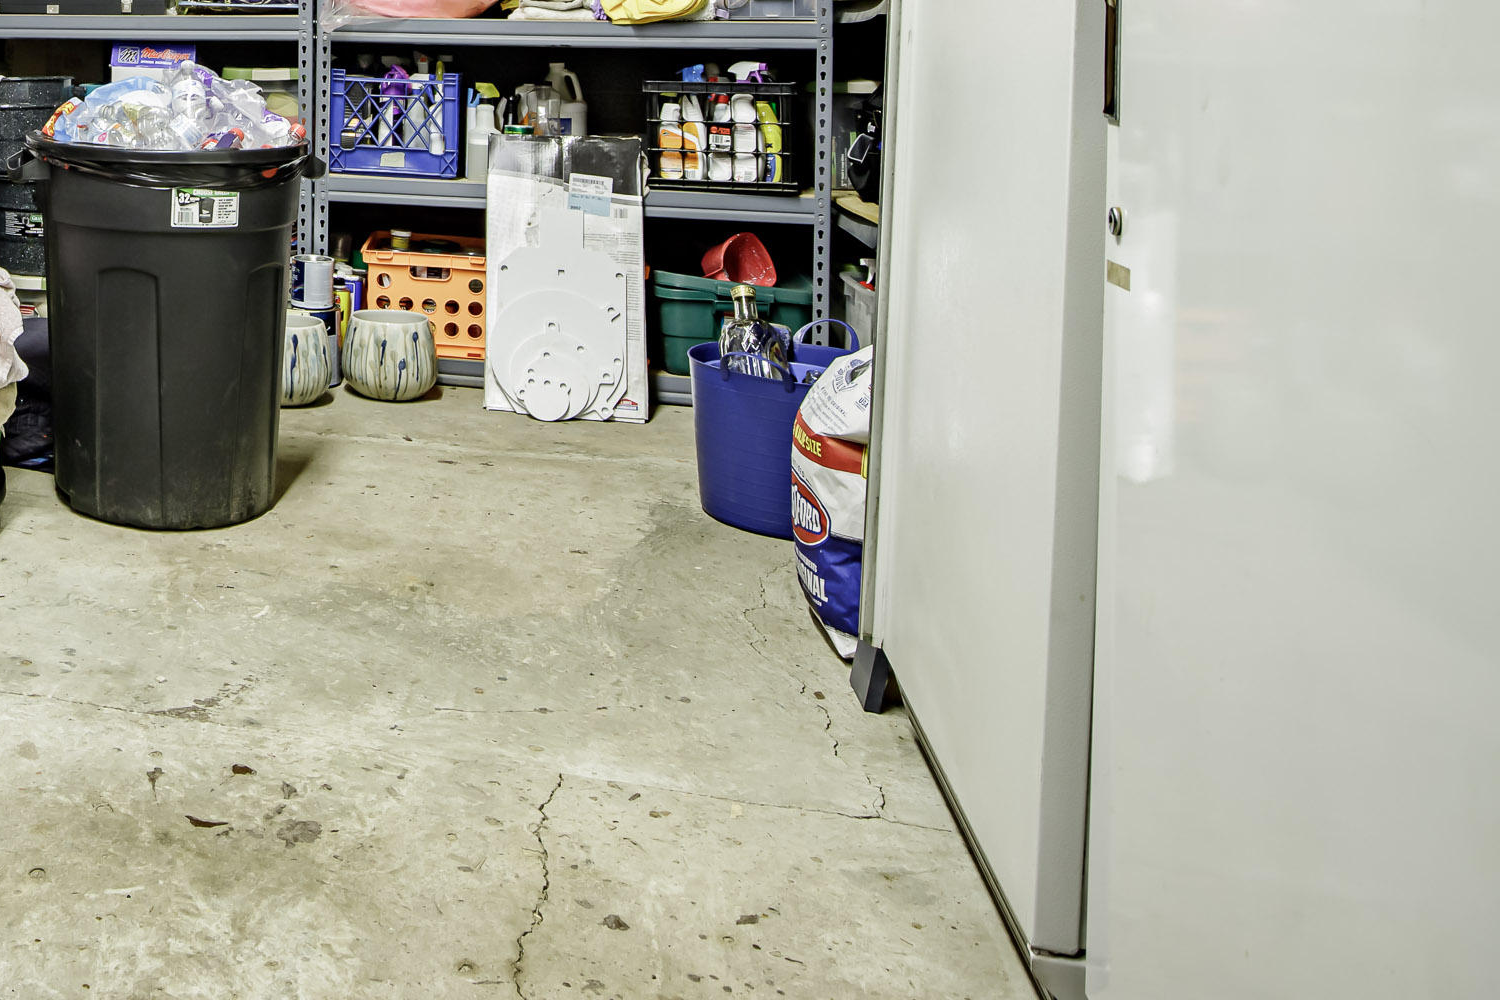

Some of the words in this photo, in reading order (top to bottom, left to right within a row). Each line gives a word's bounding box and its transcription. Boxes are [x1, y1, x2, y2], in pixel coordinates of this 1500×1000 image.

[141, 46, 191, 64] MacGregor
[179, 193, 191, 204] 32
[858, 397, 869, 409] USA
